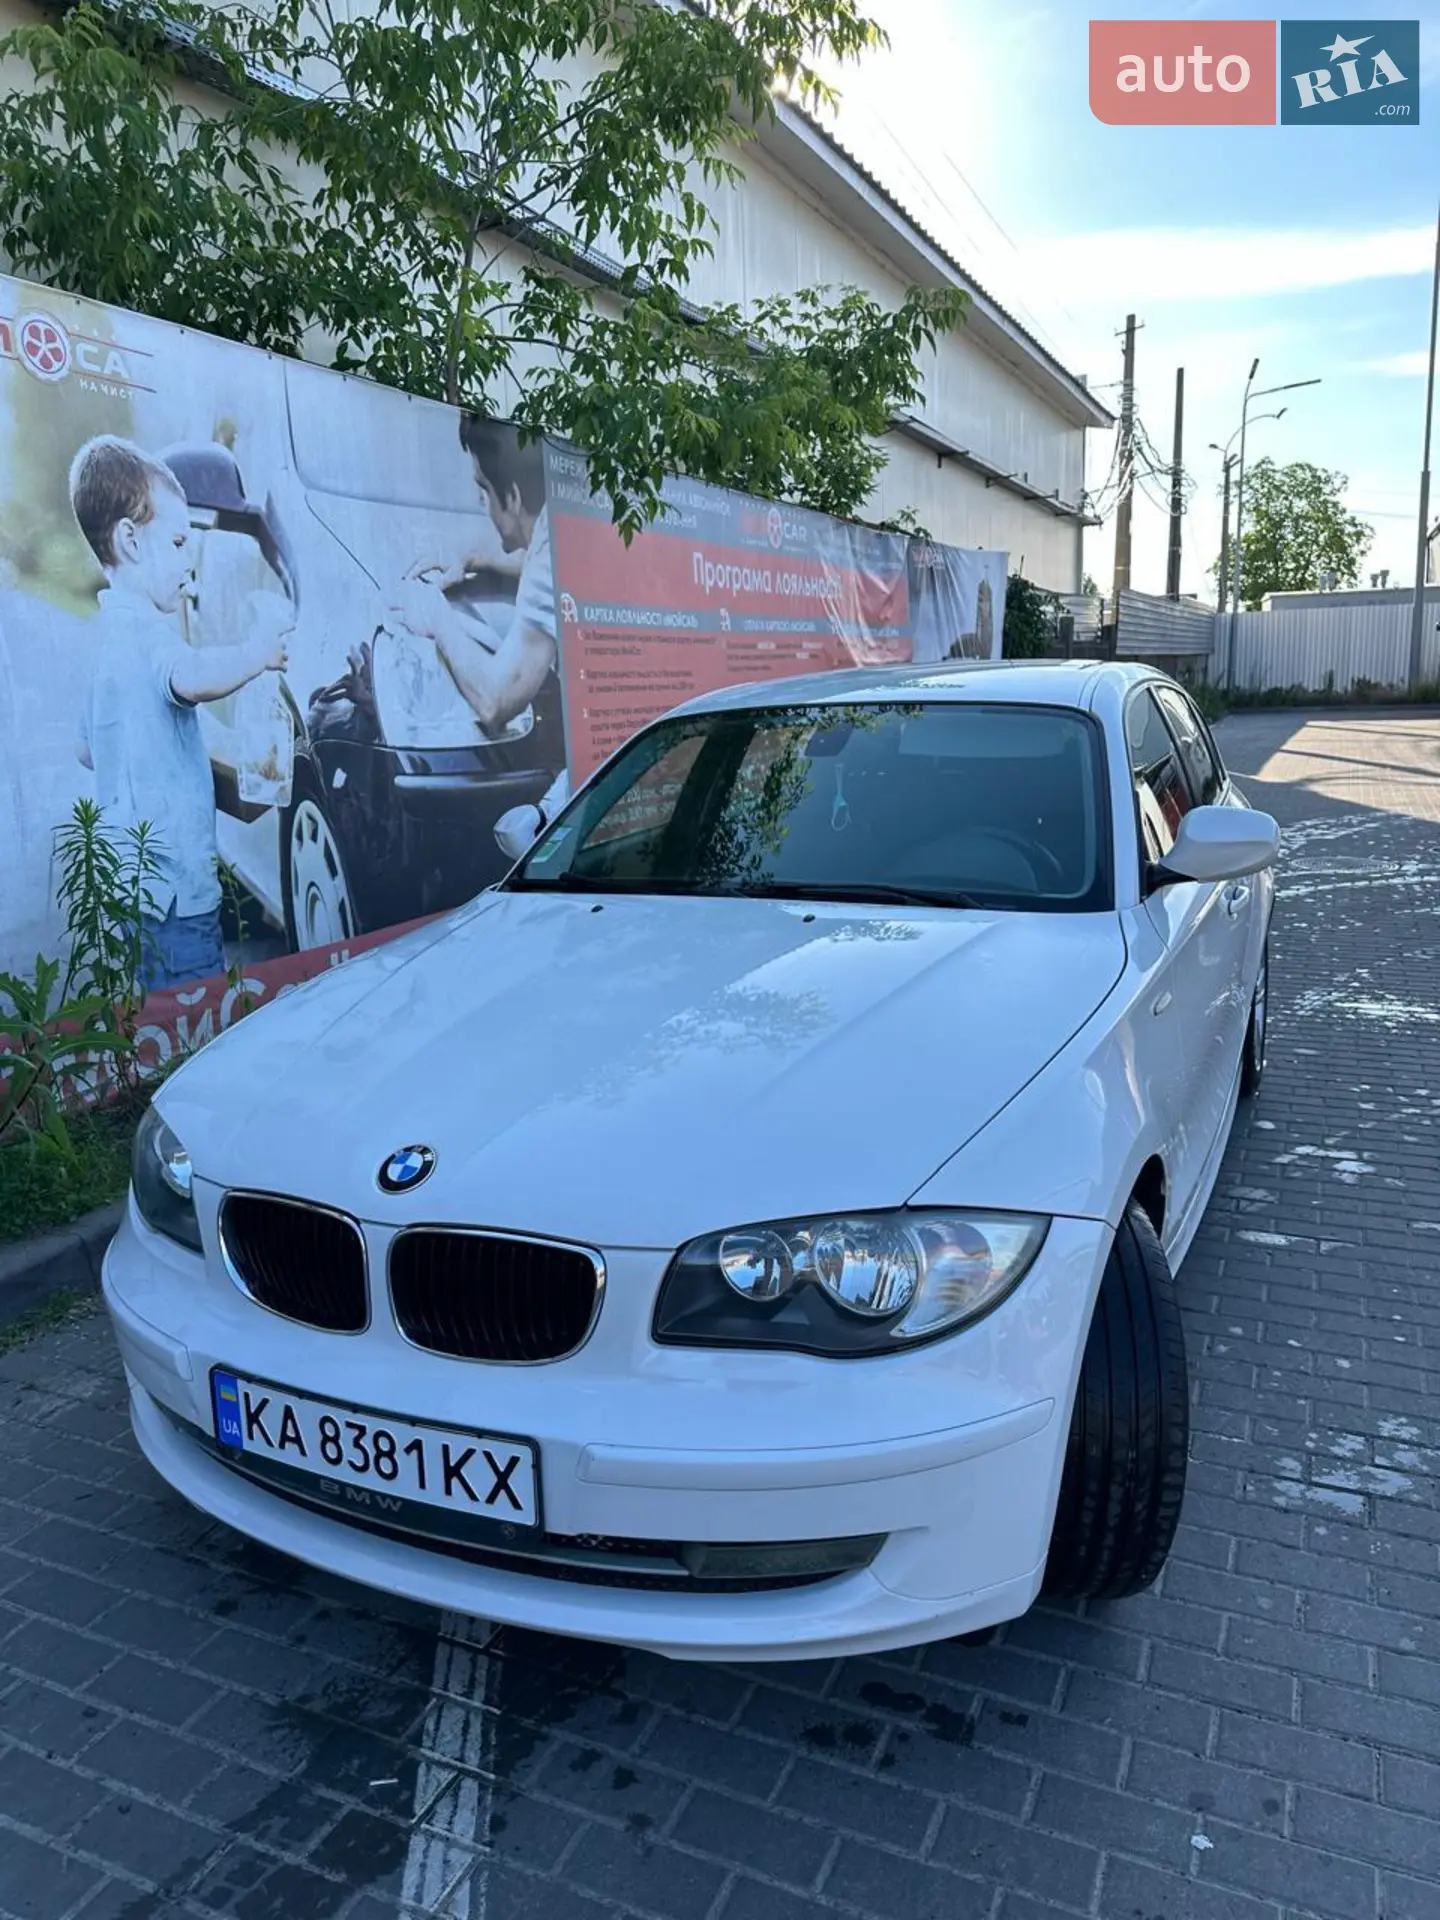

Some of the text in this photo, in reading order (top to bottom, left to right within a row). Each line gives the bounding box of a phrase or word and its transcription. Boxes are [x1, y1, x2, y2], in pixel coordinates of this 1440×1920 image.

[692, 550, 772, 597] Програма
[222, 1418, 240, 1436] UA
[243, 1391, 523, 1511] KA 8381 KX
[319, 1477, 402, 1513] BMW
